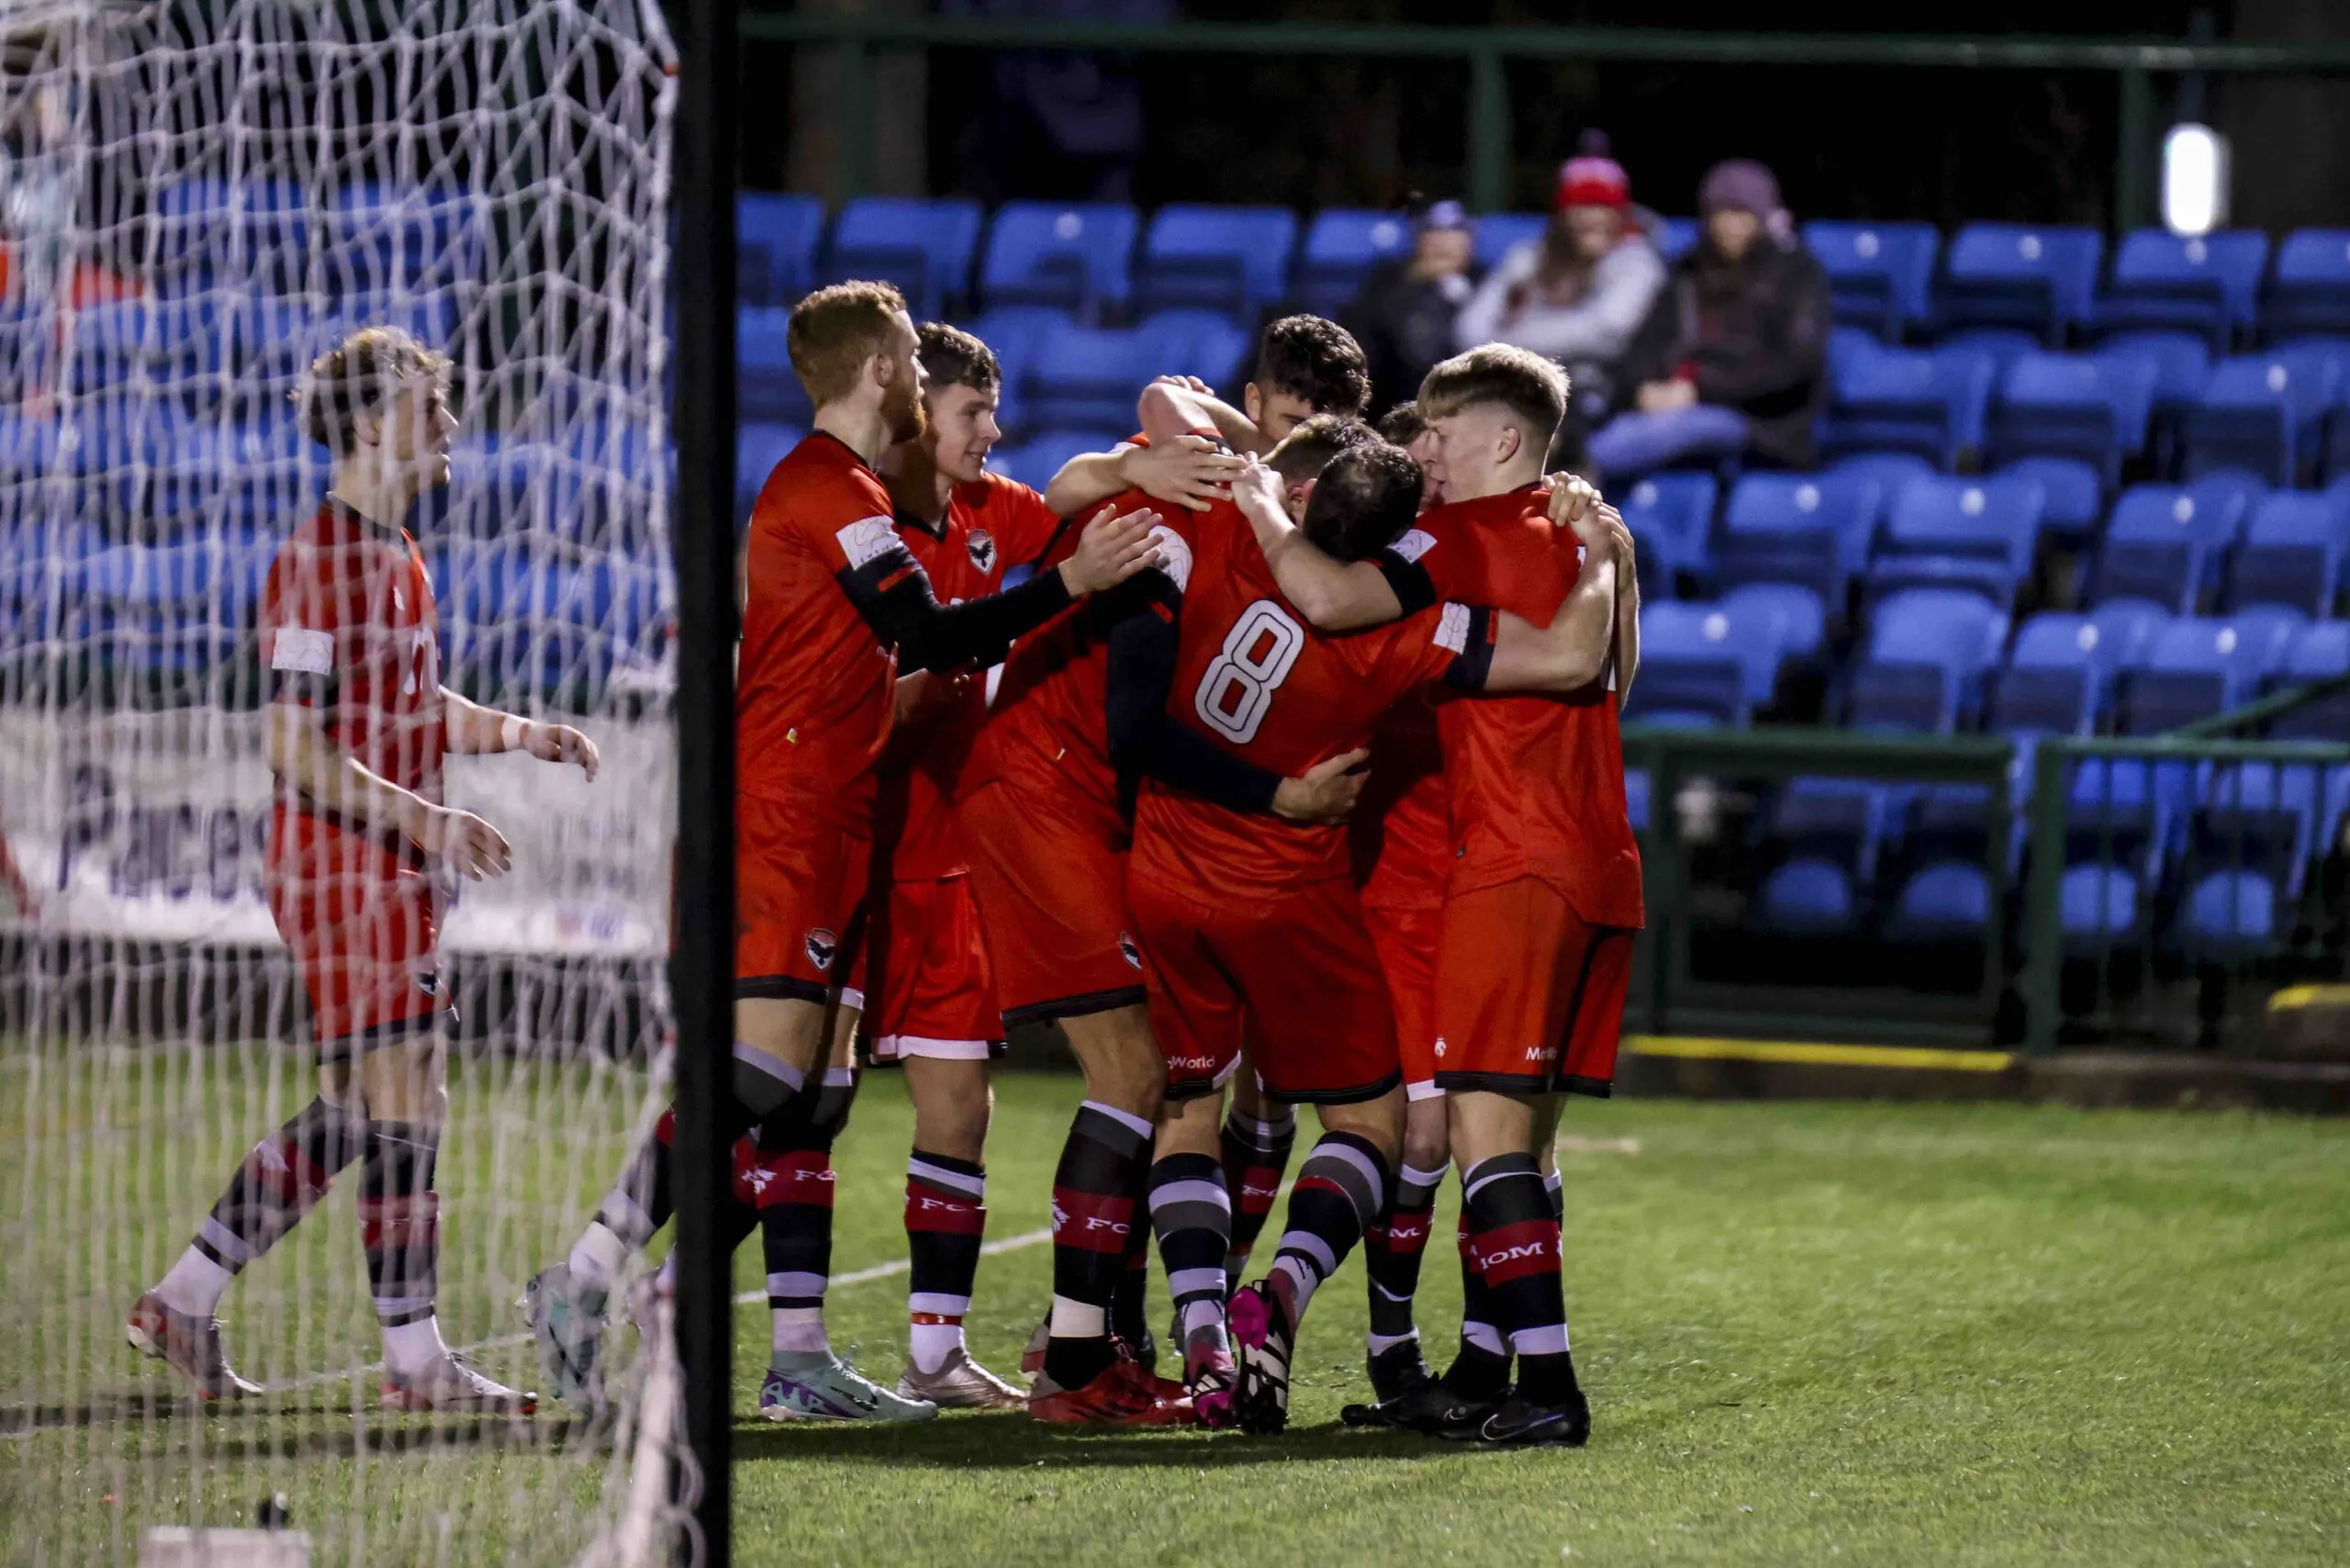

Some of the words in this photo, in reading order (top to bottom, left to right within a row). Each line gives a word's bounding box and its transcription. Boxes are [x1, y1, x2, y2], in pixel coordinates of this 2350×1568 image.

[1195, 599, 1304, 745] 8
[921, 1197, 968, 1212] FC
[1086, 1216, 1131, 1235] FC
[1480, 1241, 1544, 1270] IOM
